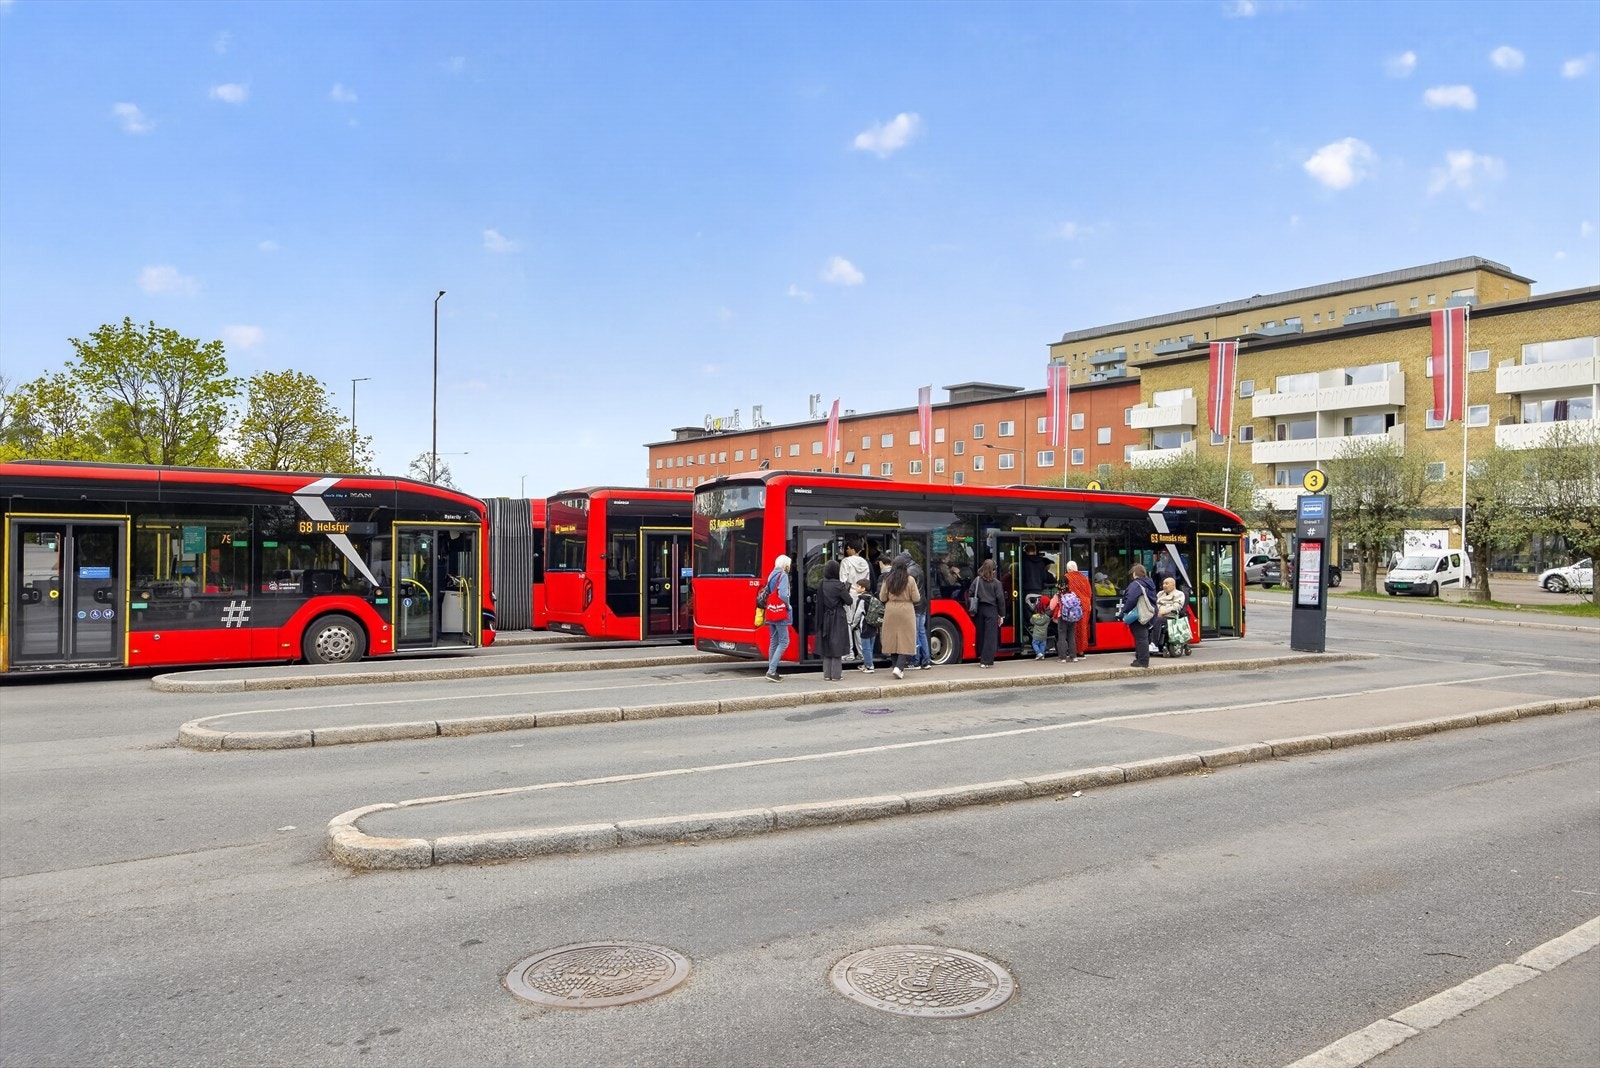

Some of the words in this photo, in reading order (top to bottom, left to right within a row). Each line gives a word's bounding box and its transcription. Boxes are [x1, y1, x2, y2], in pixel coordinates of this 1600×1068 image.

[1309, 475, 1318, 487] 3
[299, 521, 313, 533] 68
[317, 521, 350, 533] Helsfyr
[709, 519, 716, 531] 63
[1150, 533, 1158, 543] 63
